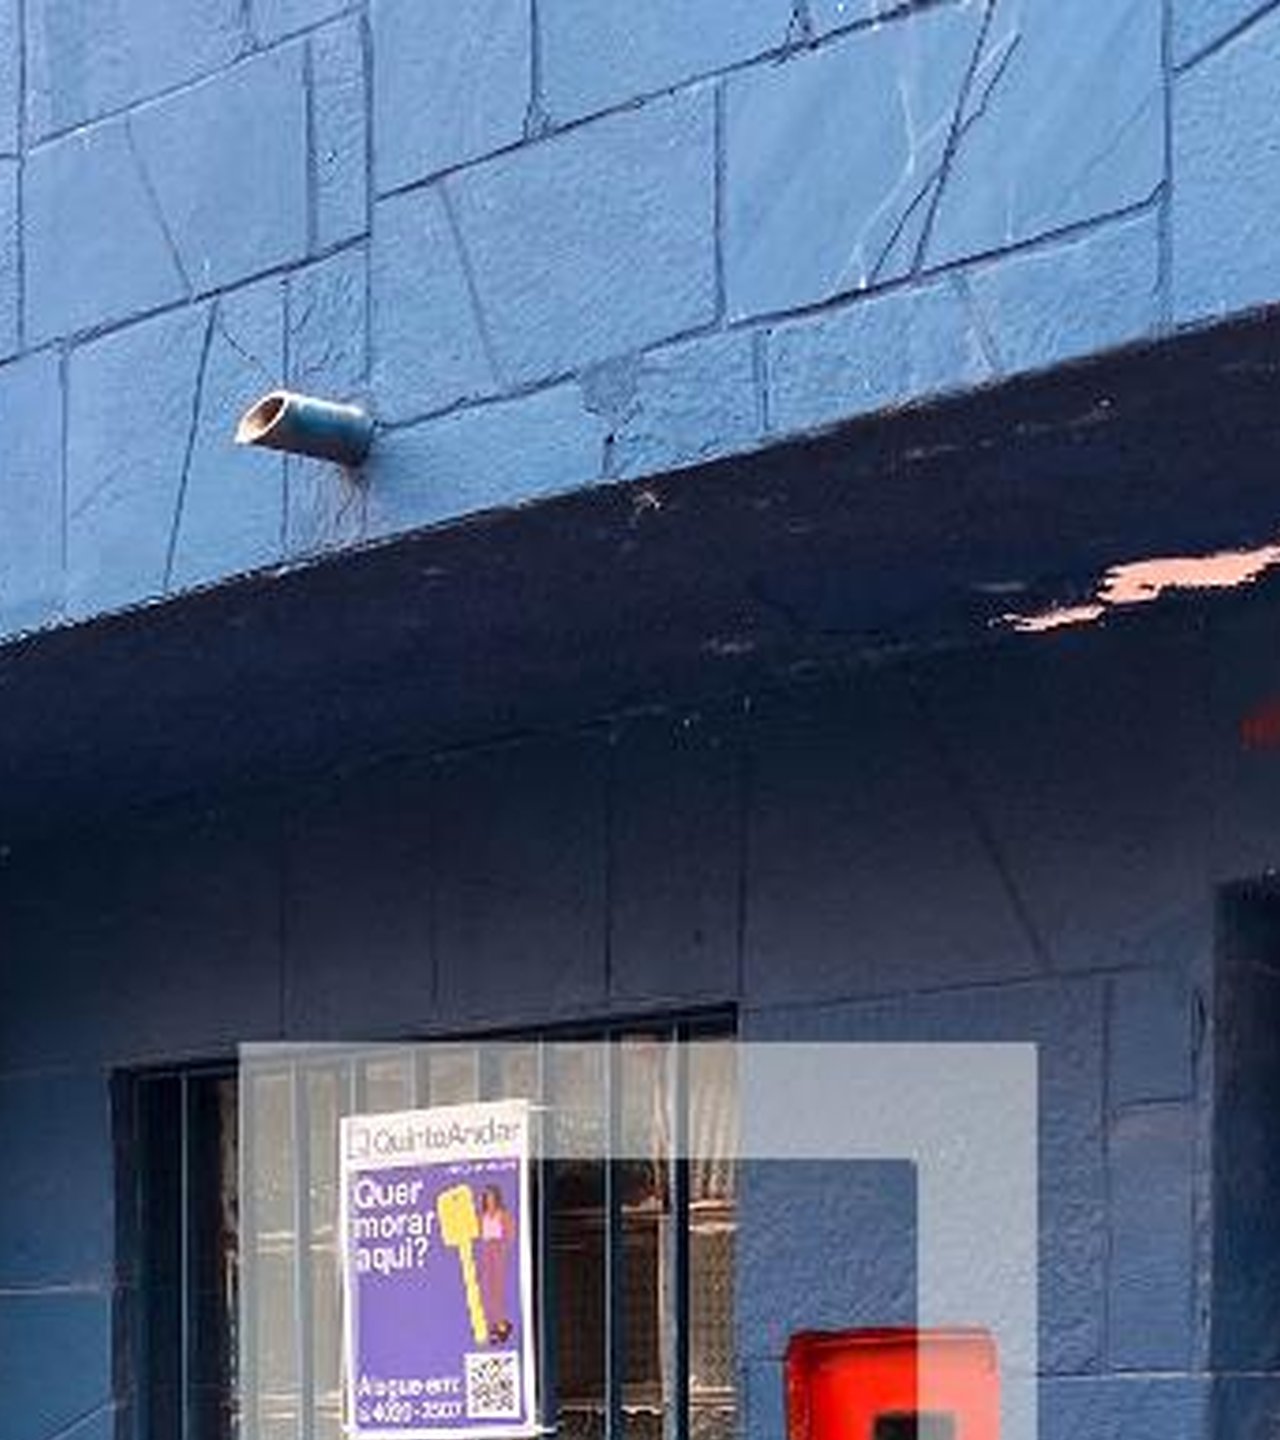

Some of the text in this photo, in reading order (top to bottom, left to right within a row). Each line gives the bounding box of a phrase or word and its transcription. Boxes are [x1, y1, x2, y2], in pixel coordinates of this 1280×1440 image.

[374, 1117, 521, 1155] QuintoAndar
[354, 1178, 423, 1209] Quer
[353, 1211, 435, 1238] morar
[356, 1237, 428, 1275] aqui?
